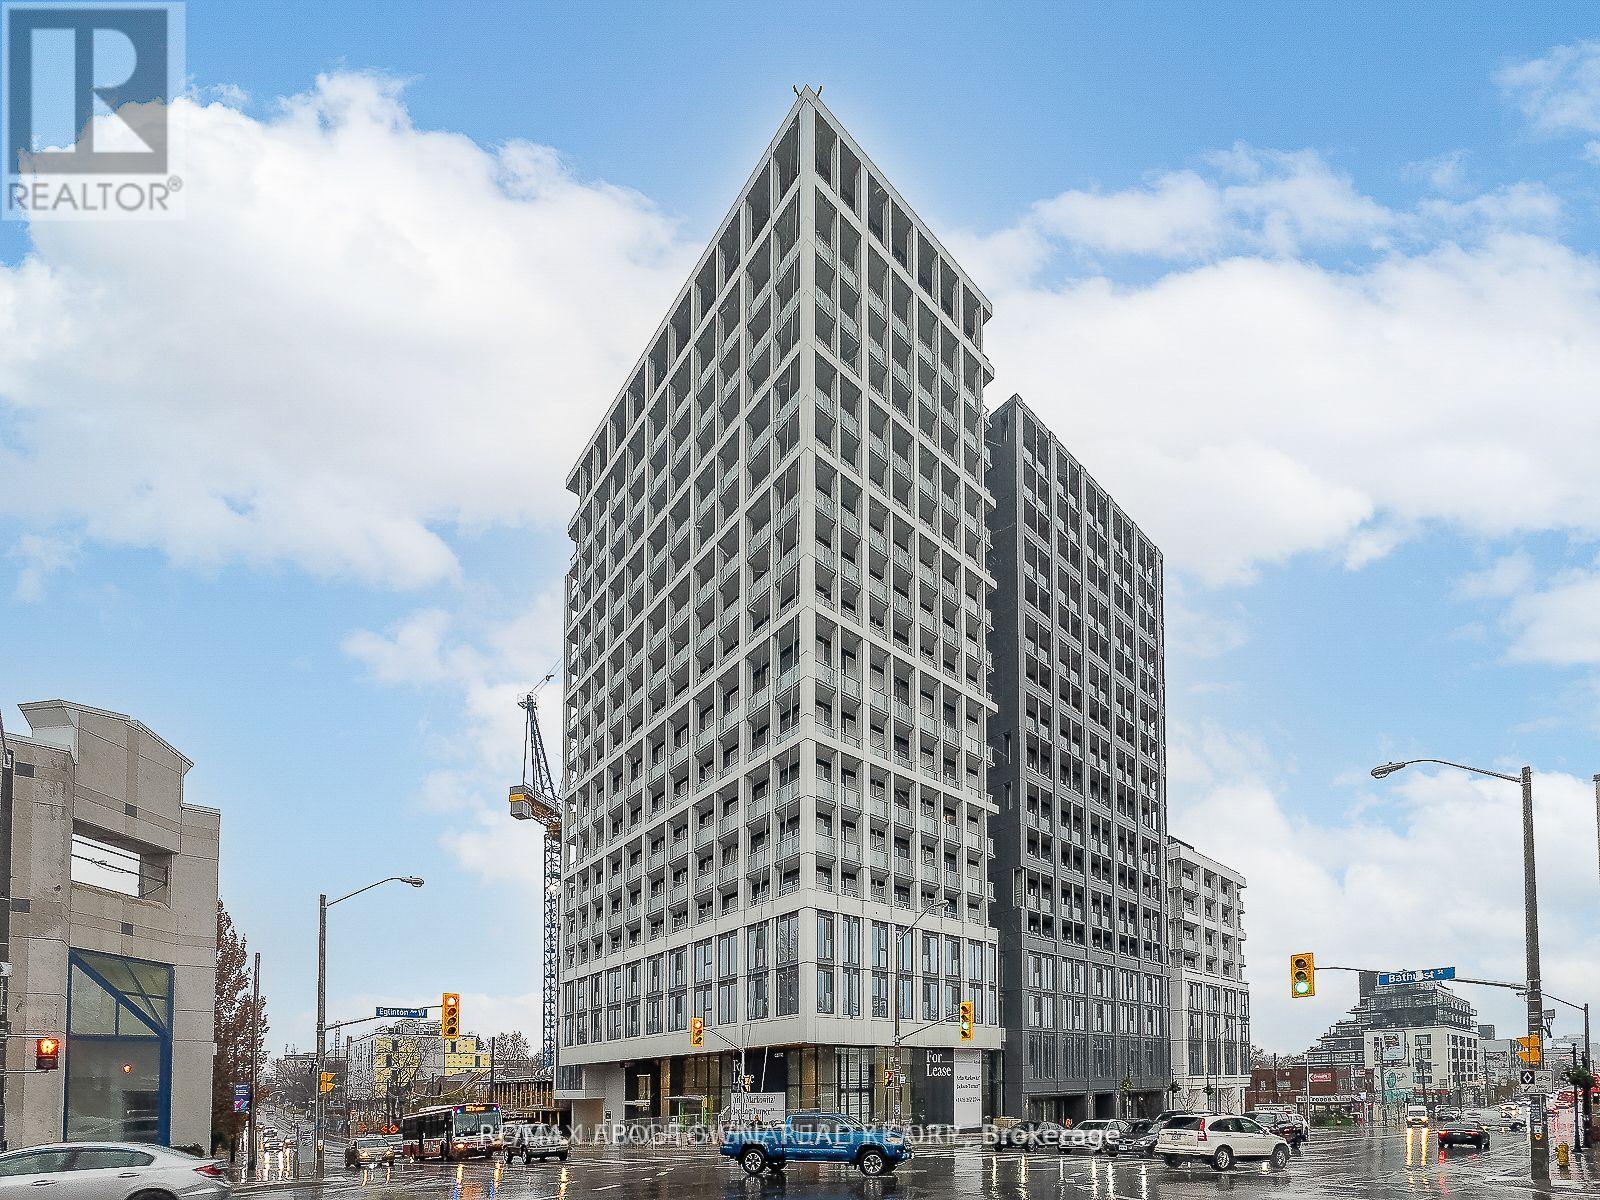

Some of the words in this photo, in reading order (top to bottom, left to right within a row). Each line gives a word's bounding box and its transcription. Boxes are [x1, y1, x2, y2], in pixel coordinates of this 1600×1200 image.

[1388, 970, 1435, 983] Bathust
[379, 1008, 409, 1017] Eglinton
[926, 1050, 942, 1063] For
[926, 1063, 952, 1077] Lease
